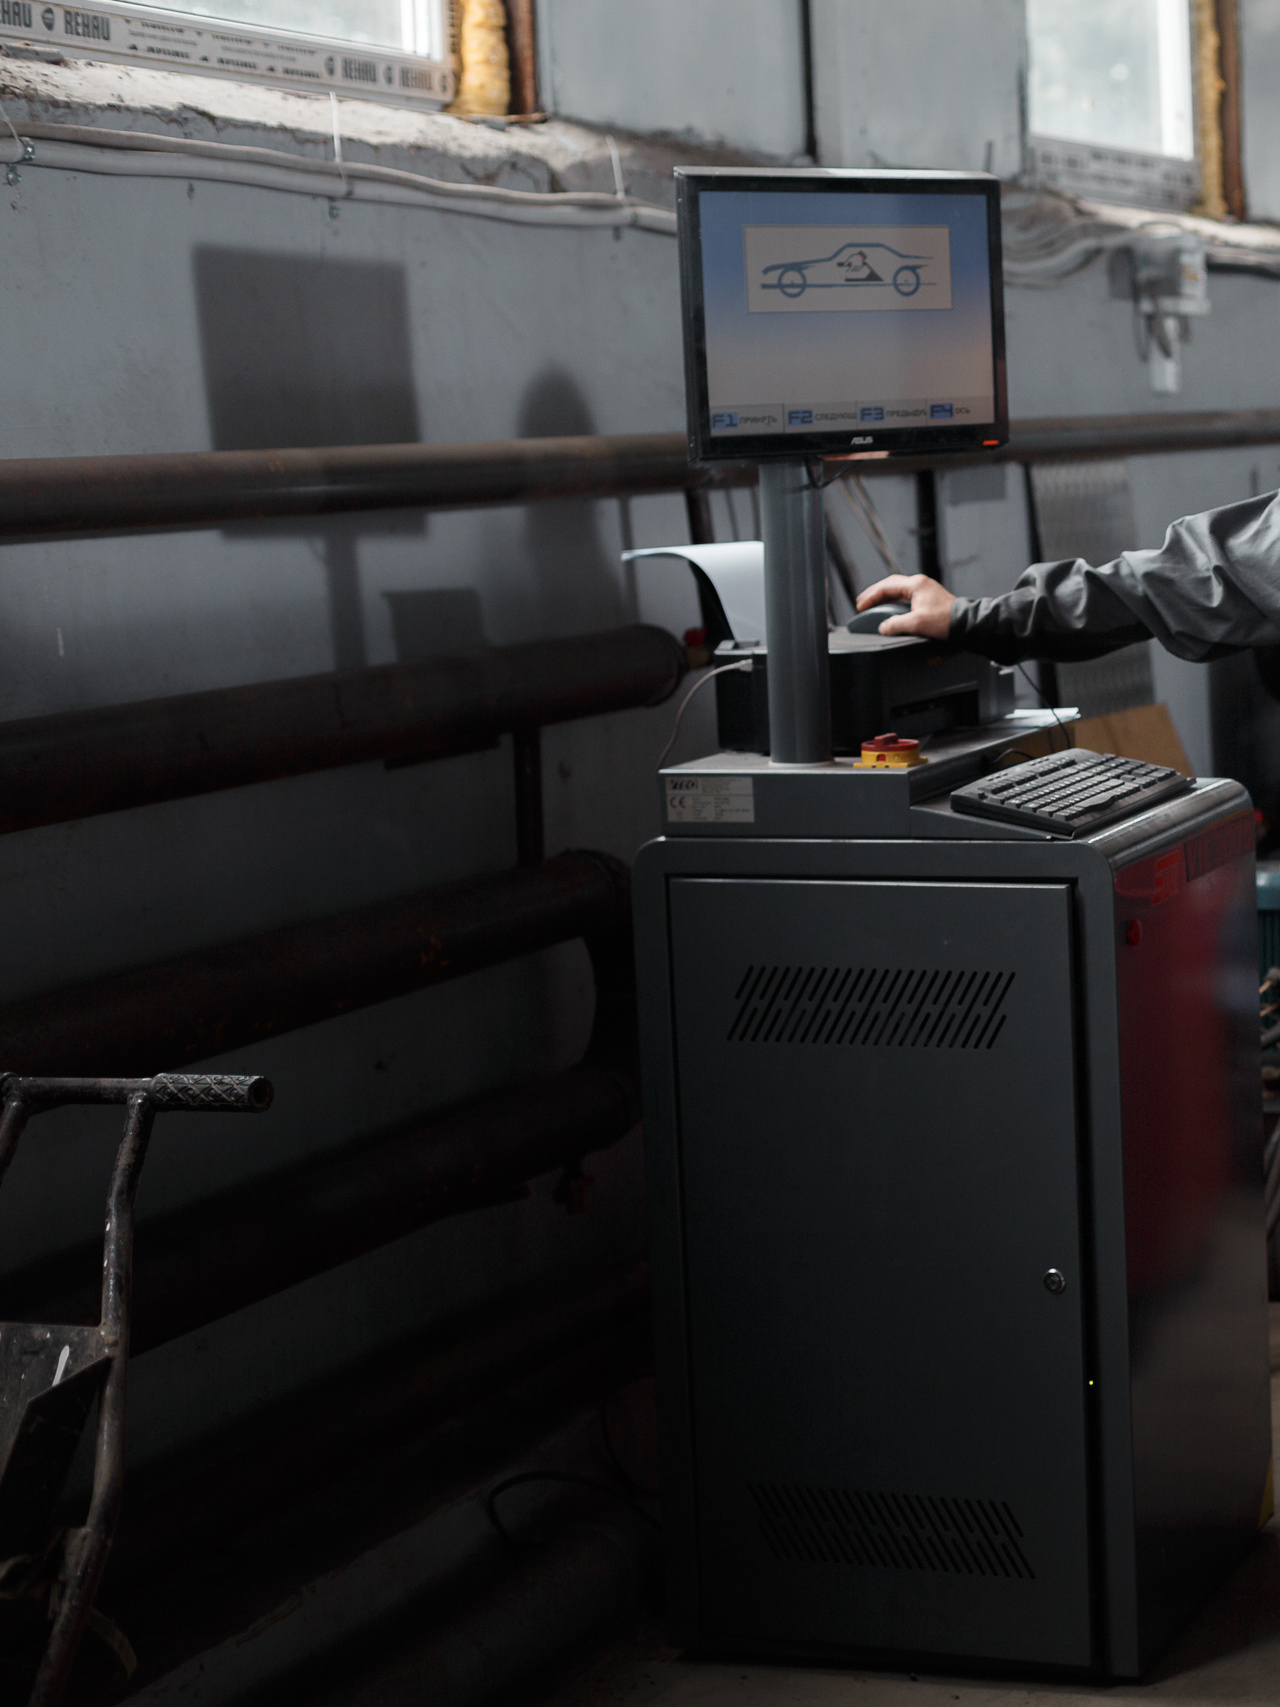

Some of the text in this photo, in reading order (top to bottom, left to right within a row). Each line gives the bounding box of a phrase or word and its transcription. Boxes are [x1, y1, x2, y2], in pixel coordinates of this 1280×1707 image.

[0, 0, 32, 28] HAU
[63, 9, 111, 41] REHAU
[787, 410, 812, 425] F2
[860, 406, 884, 421] F3
[930, 404, 953, 418] F4
[711, 413, 738, 429] F1
[851, 436, 873, 445] ASUS
